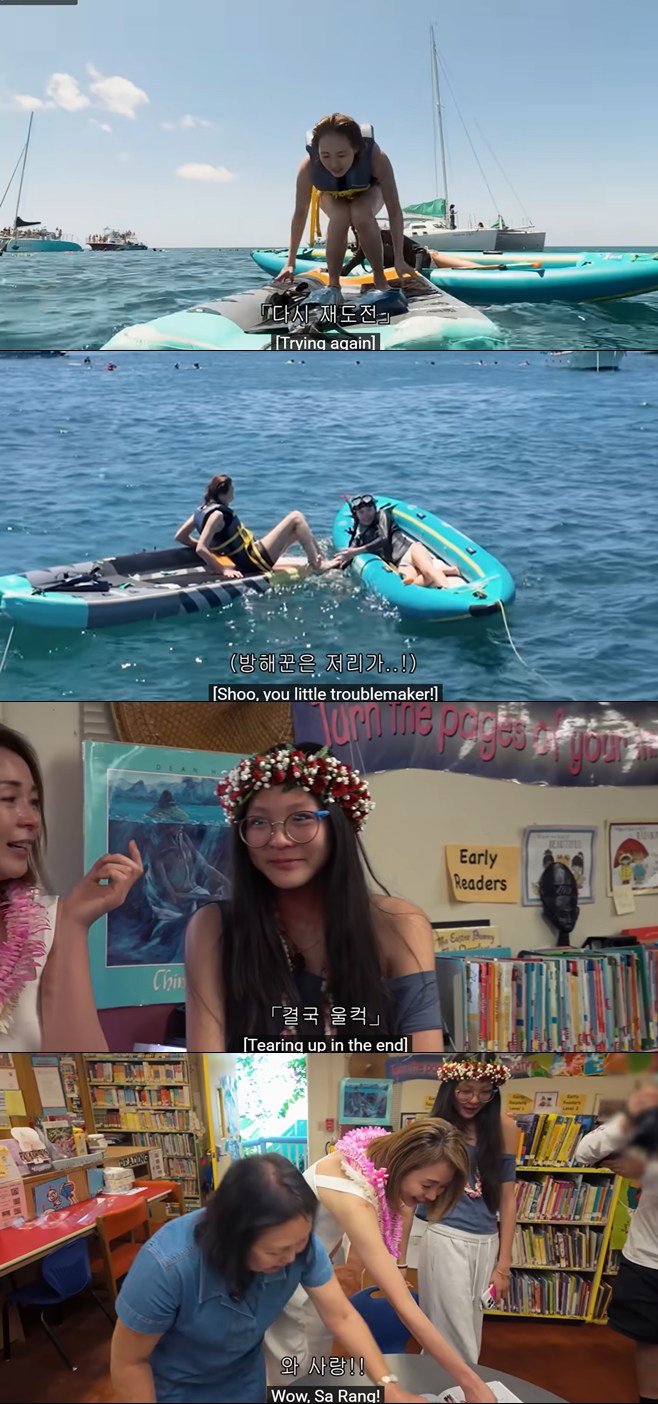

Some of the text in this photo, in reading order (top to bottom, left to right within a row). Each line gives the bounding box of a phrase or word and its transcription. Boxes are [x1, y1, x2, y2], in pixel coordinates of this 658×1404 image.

[309, 702, 382, 747] Turn
[389, 702, 433, 736] the
[438, 703, 526, 762] pages
[533, 707, 565, 762] of
[569, 730, 628, 776] your
[460, 849, 498, 869] Early
[454, 873, 507, 891] Readers
